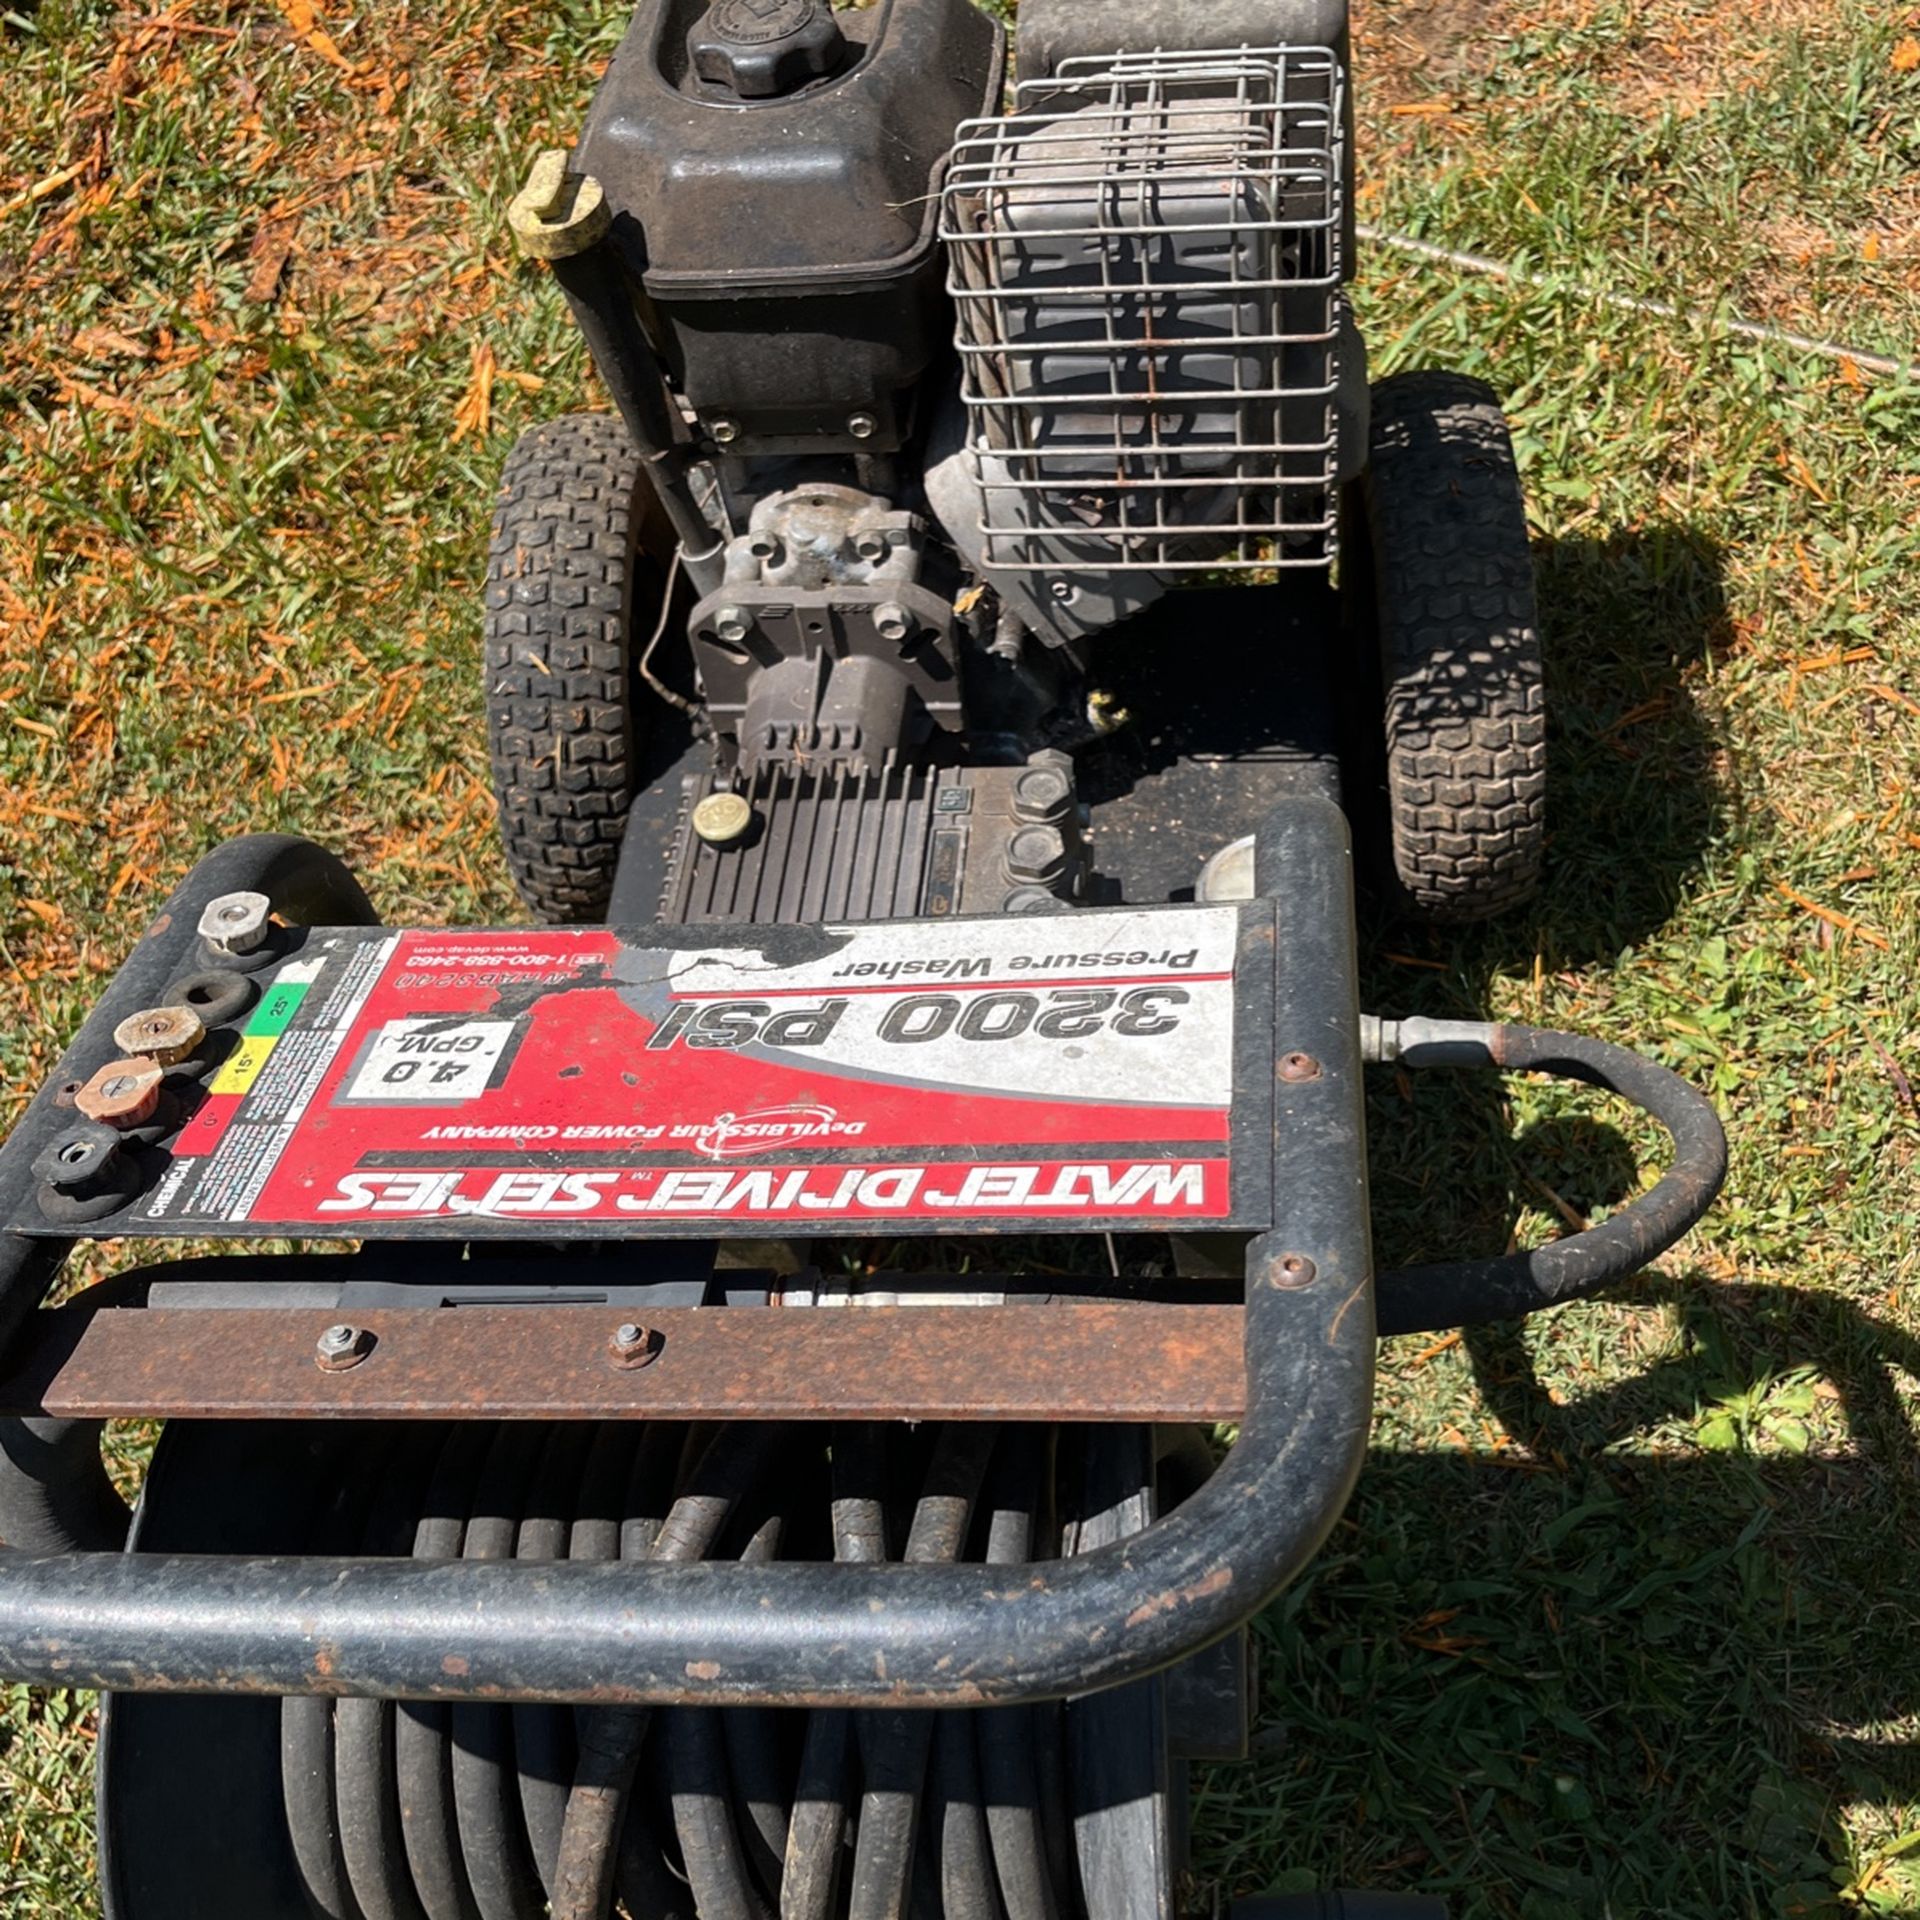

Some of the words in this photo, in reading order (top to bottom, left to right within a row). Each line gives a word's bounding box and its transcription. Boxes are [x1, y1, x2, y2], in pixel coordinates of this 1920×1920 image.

[405, 954, 568, 967] 1-800-888-2463
[413, 945, 530, 955] www.devap.com
[1009, 949, 1199, 970] Pressure
[833, 958, 992, 980] Washer
[645, 998, 850, 1051] PSI
[877, 986, 1190, 1043] 3200
[398, 1036, 484, 1054] GPM
[381, 1060, 470, 1083] 4.0
[420, 1126, 558, 1139] COMPANY
[561, 1125, 665, 1139] POWER
[669, 1124, 720, 1138] AIR
[727, 1121, 867, 1139] DeVILBISS
[147, 1156, 195, 1218] CHEMICAL
[316, 1171, 622, 1212] SERIES
[615, 1168, 926, 1211] DRIVER
[922, 1162, 1204, 1208] WATER
